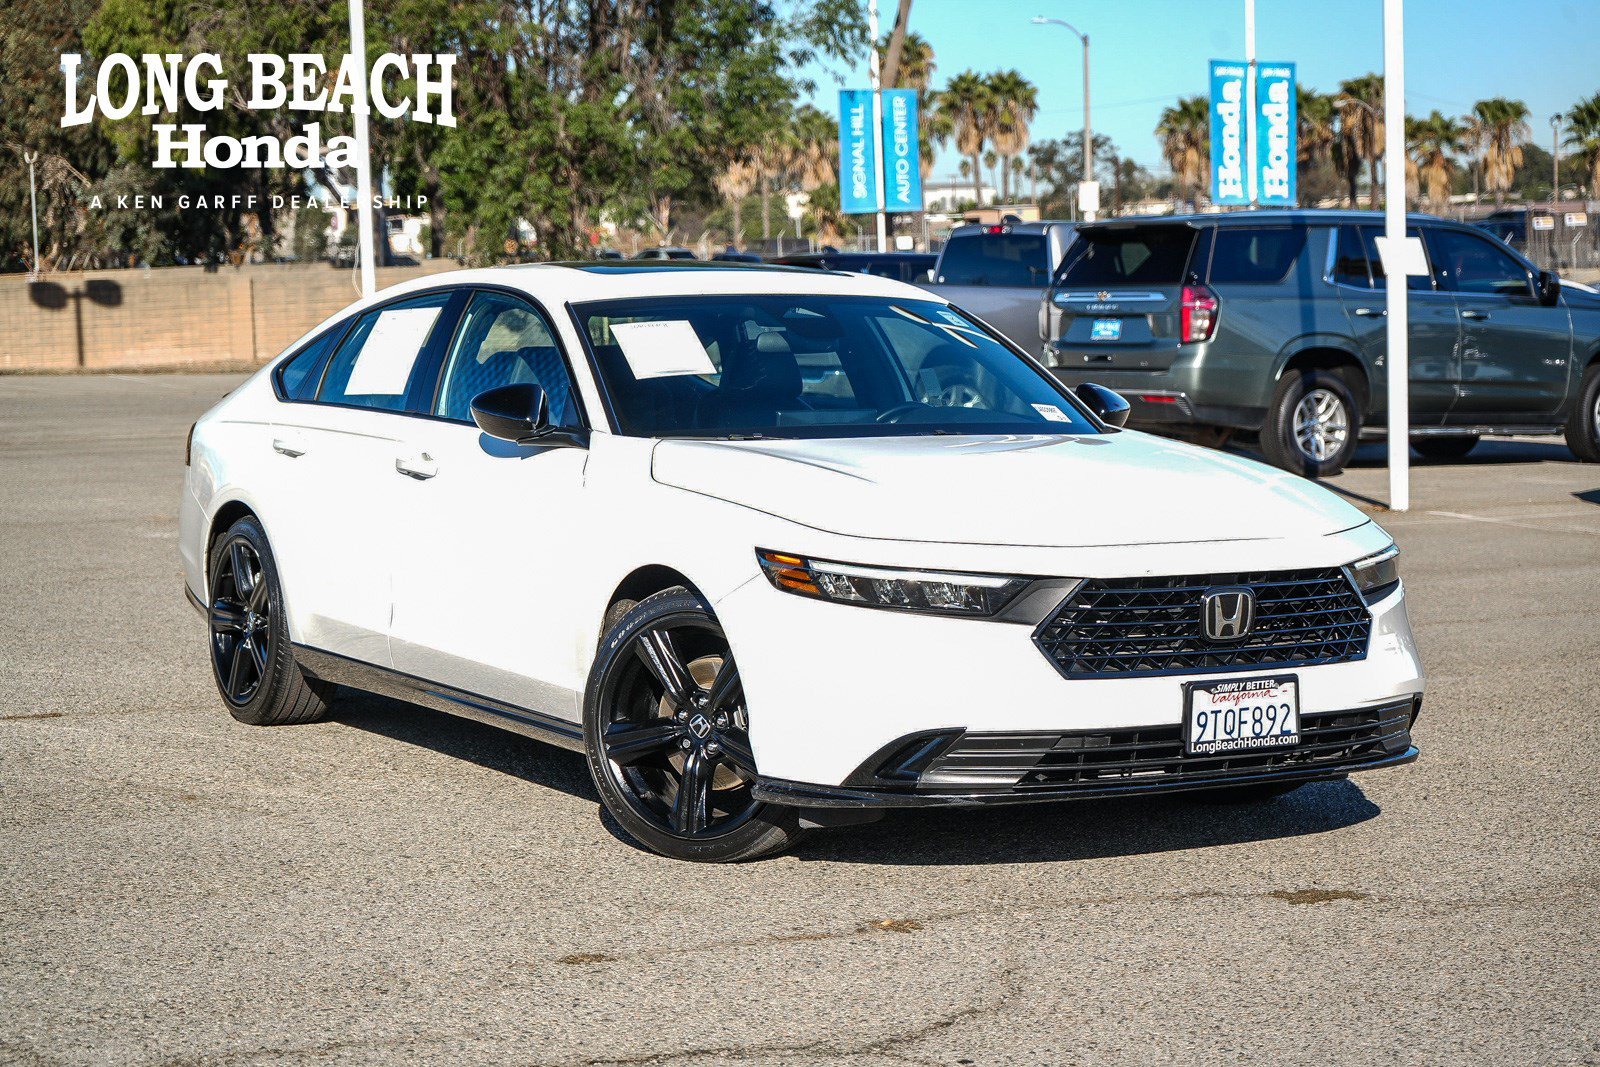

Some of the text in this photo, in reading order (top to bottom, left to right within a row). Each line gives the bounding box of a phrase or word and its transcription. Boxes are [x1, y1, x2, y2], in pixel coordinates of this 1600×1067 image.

[851, 104, 867, 199] SIGNAL HILL
[893, 96, 910, 203] AUTO CENTER
[1217, 79, 1243, 198] Honda
[1262, 80, 1288, 198] Honda
[1212, 689, 1277, 706] California
[1216, 680, 1275, 693] SIMPLY BETTER
[1191, 735, 1299, 754] LongBeachHonda.com
[1197, 703, 1291, 742] 9TQF892
